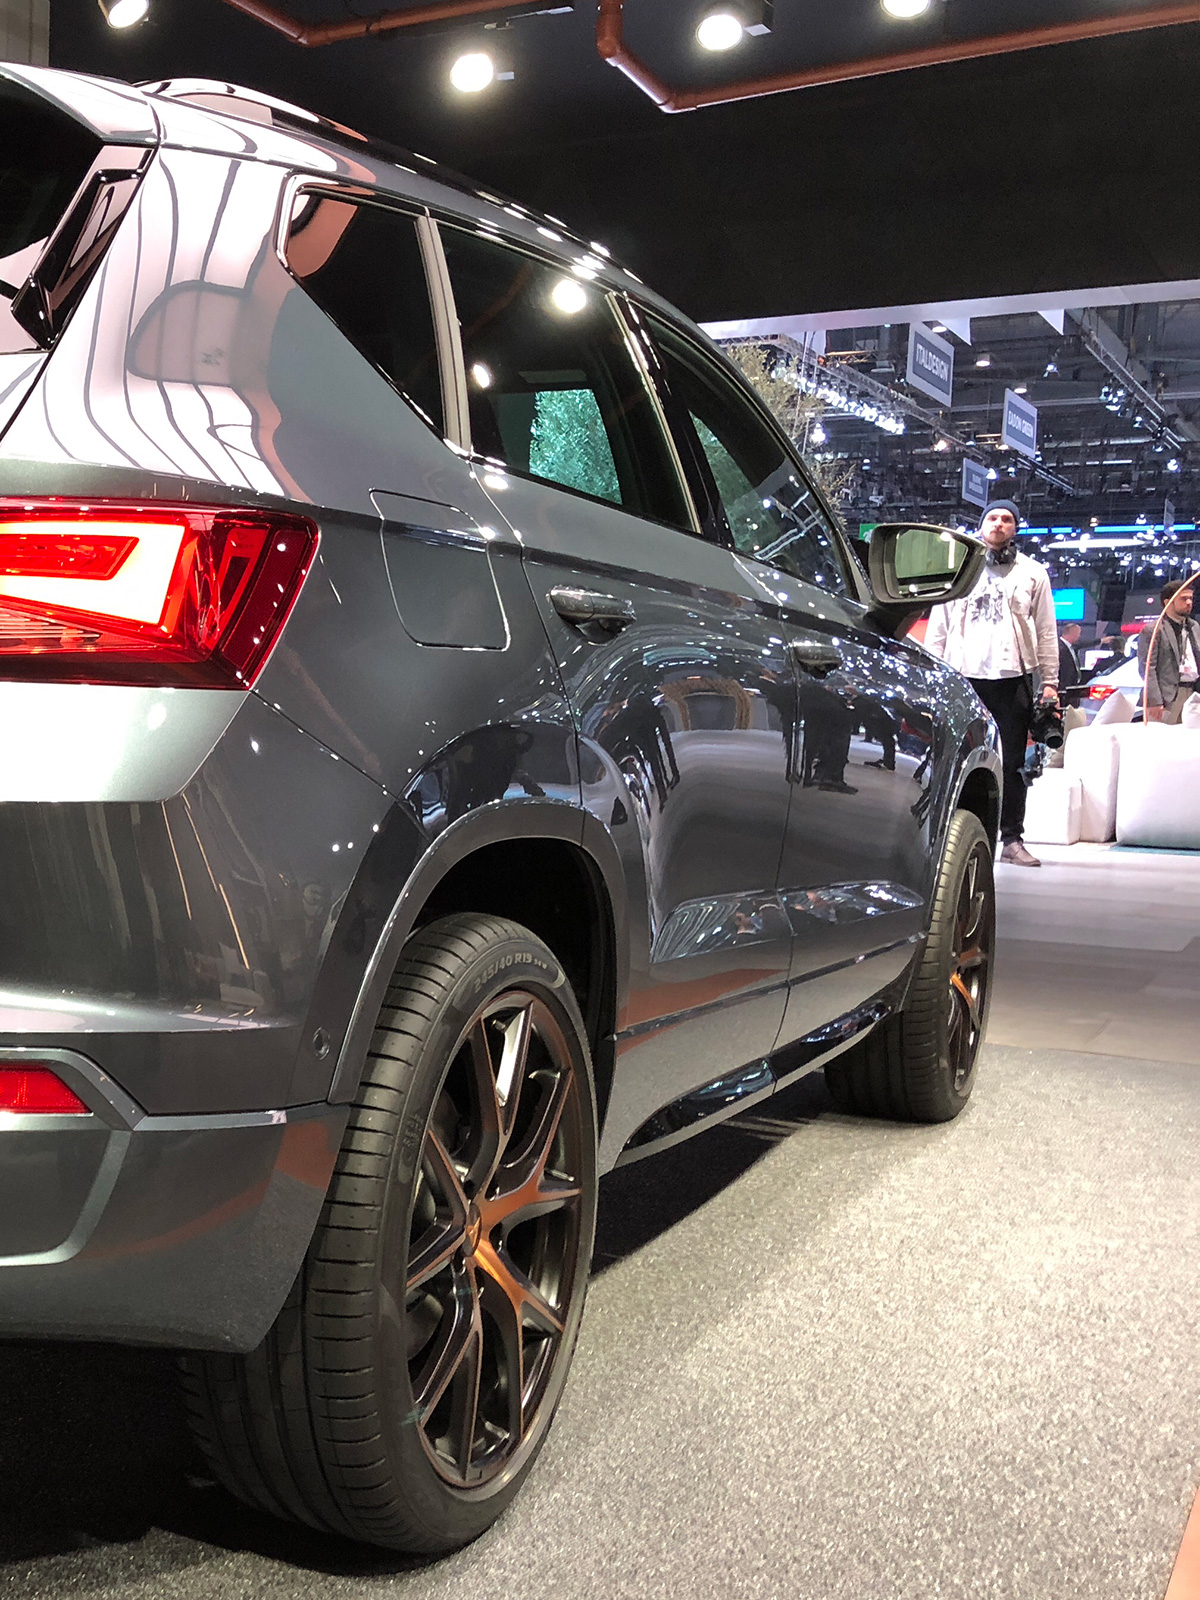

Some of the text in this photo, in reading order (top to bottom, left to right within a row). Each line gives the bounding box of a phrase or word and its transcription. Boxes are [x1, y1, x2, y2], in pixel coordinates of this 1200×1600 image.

[916, 343, 948, 382] ITALDESIGN
[474, 955, 513, 993] 245/40
[514, 953, 533, 964] R19
